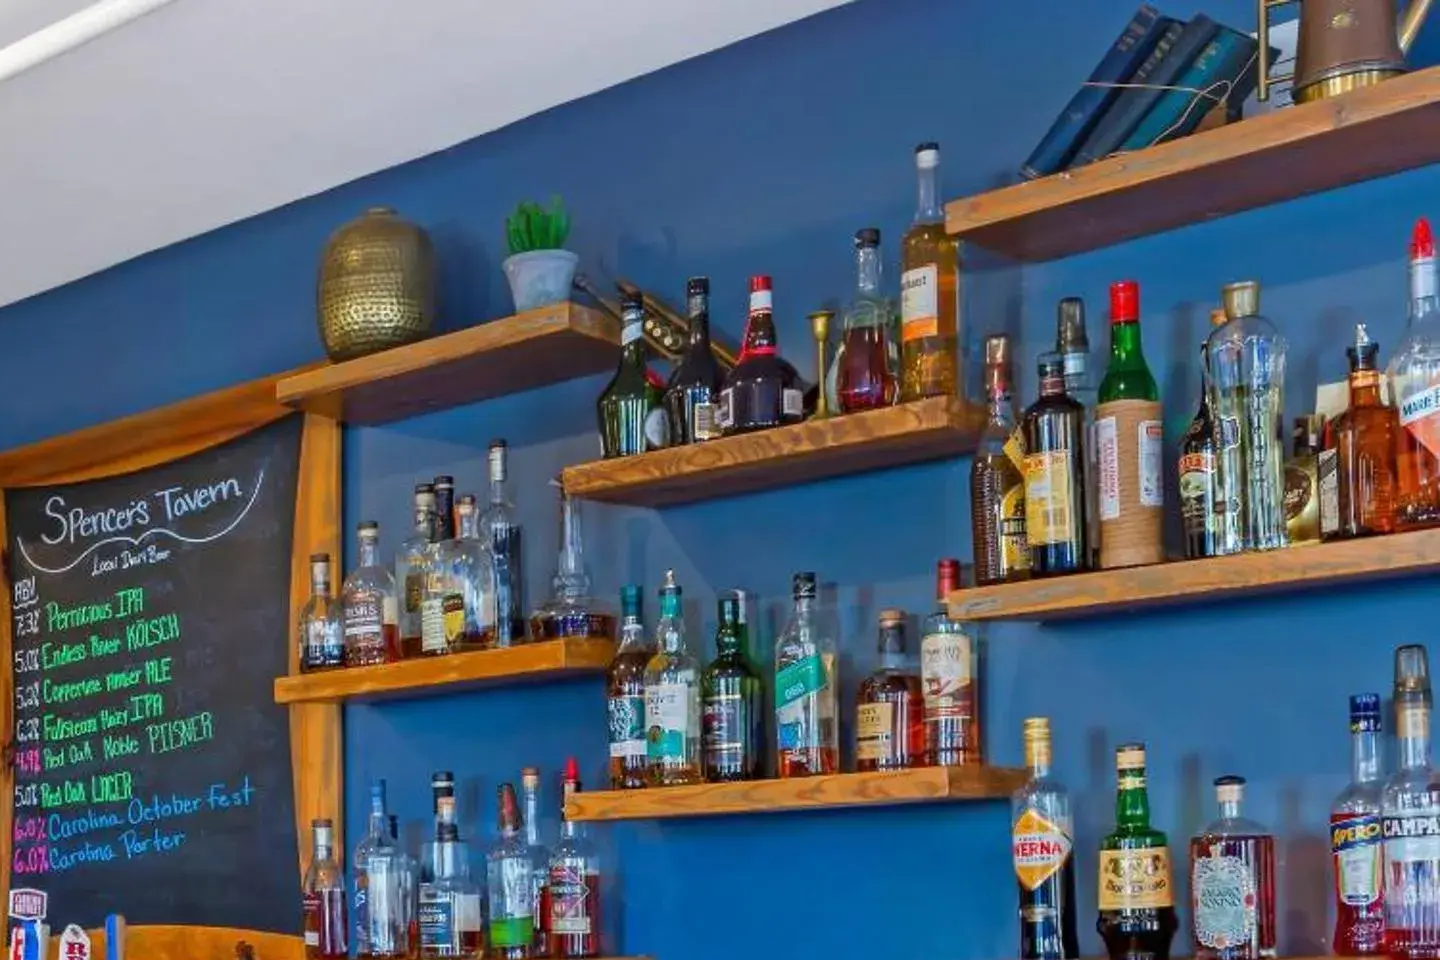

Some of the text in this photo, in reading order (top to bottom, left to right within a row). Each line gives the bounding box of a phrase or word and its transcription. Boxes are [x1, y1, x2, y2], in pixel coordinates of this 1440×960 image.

[41, 478, 242, 544] Spencer's Tavern
[46, 601, 113, 633] Pernicious
[114, 587, 144, 618] IPA
[42, 641, 87, 670] Endless
[126, 613, 181, 651] KÖLSCH
[145, 658, 173, 685] ALE
[100, 708, 128, 732] Hazy
[130, 693, 163, 722] IPA
[44, 748, 65, 772] Red
[103, 734, 140, 761] Noble
[146, 711, 215, 754] PILSNER
[41, 781, 63, 808] Red
[91, 771, 133, 804] LAGER
[48, 808, 124, 842] Carolina
[127, 793, 202, 825] October
[206, 775, 258, 812] Fest
[1333, 821, 1381, 847] APERO
[1383, 816, 1440, 838] CAMPA
[12, 826, 186, 875] 6.0% Carolina Porter
[1010, 839, 1064, 858] VERNA
